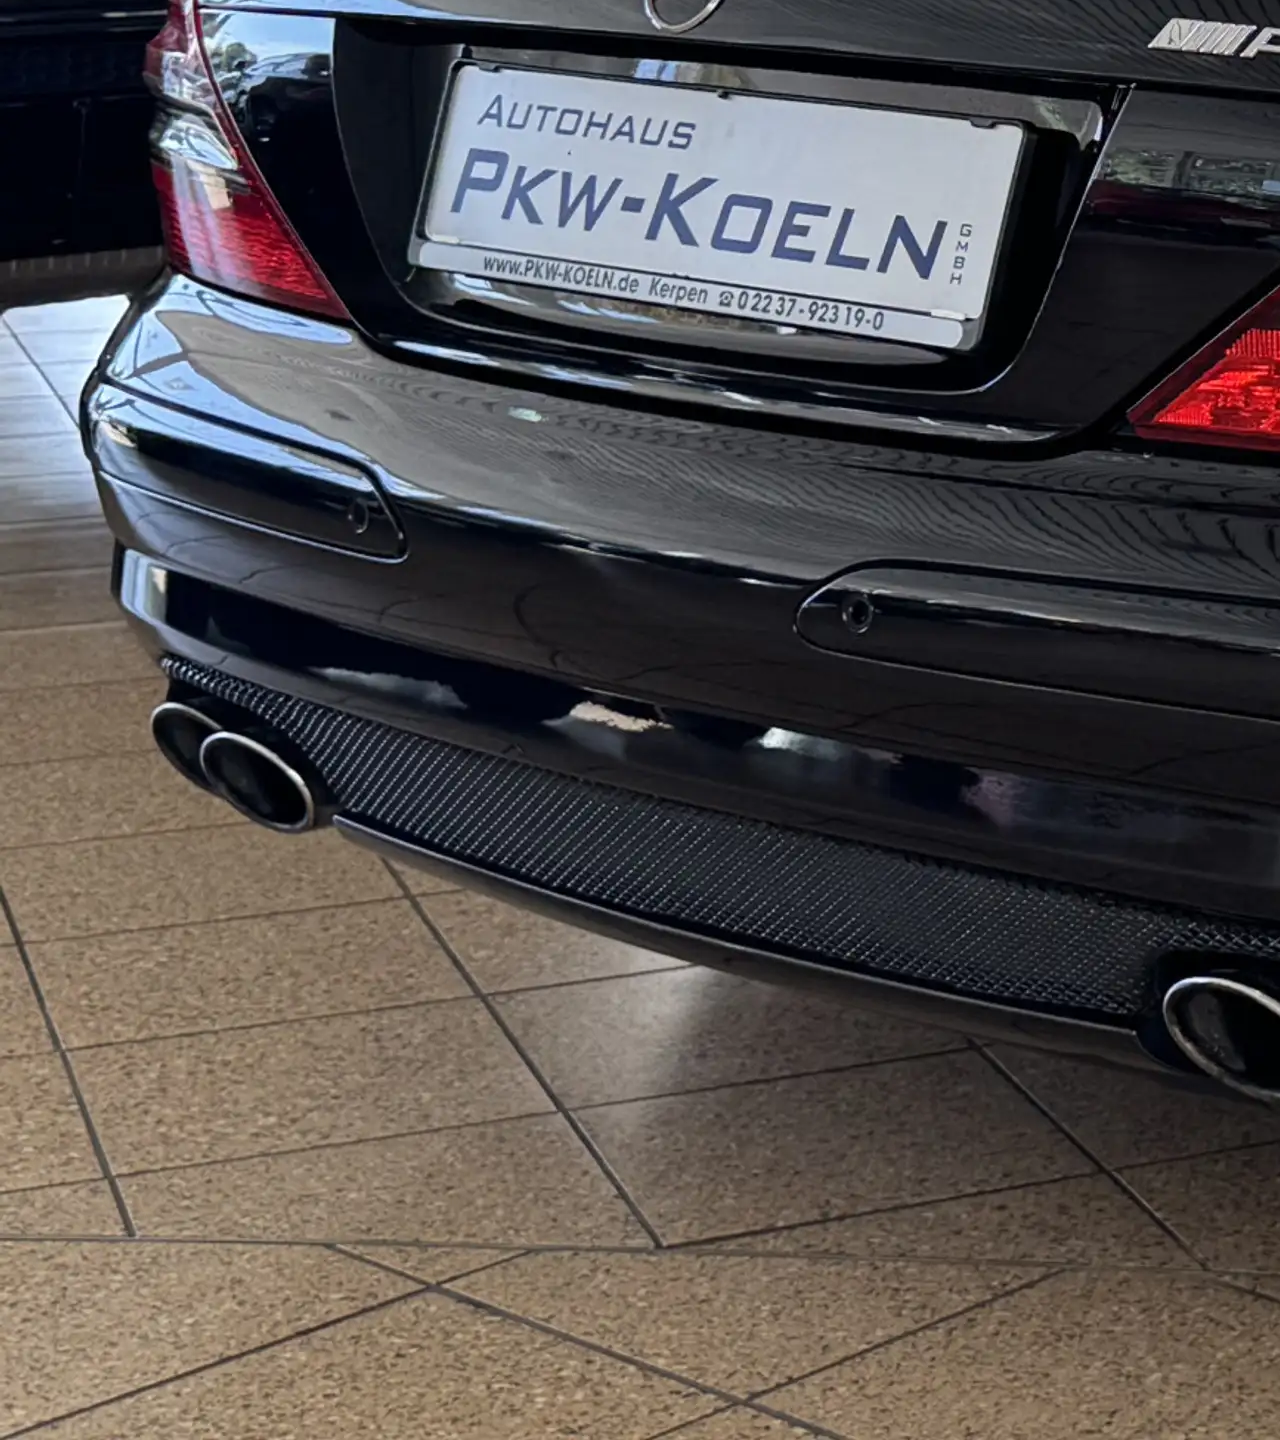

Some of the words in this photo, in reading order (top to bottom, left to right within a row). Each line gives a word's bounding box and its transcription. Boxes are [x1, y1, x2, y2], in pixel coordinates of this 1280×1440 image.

[477, 94, 697, 150] AUTOHAUS
[450, 147, 948, 281] PKW-KOELN
[483, 256, 640, 294] www.PKW-KOELN.de
[648, 276, 708, 304] Kerpen
